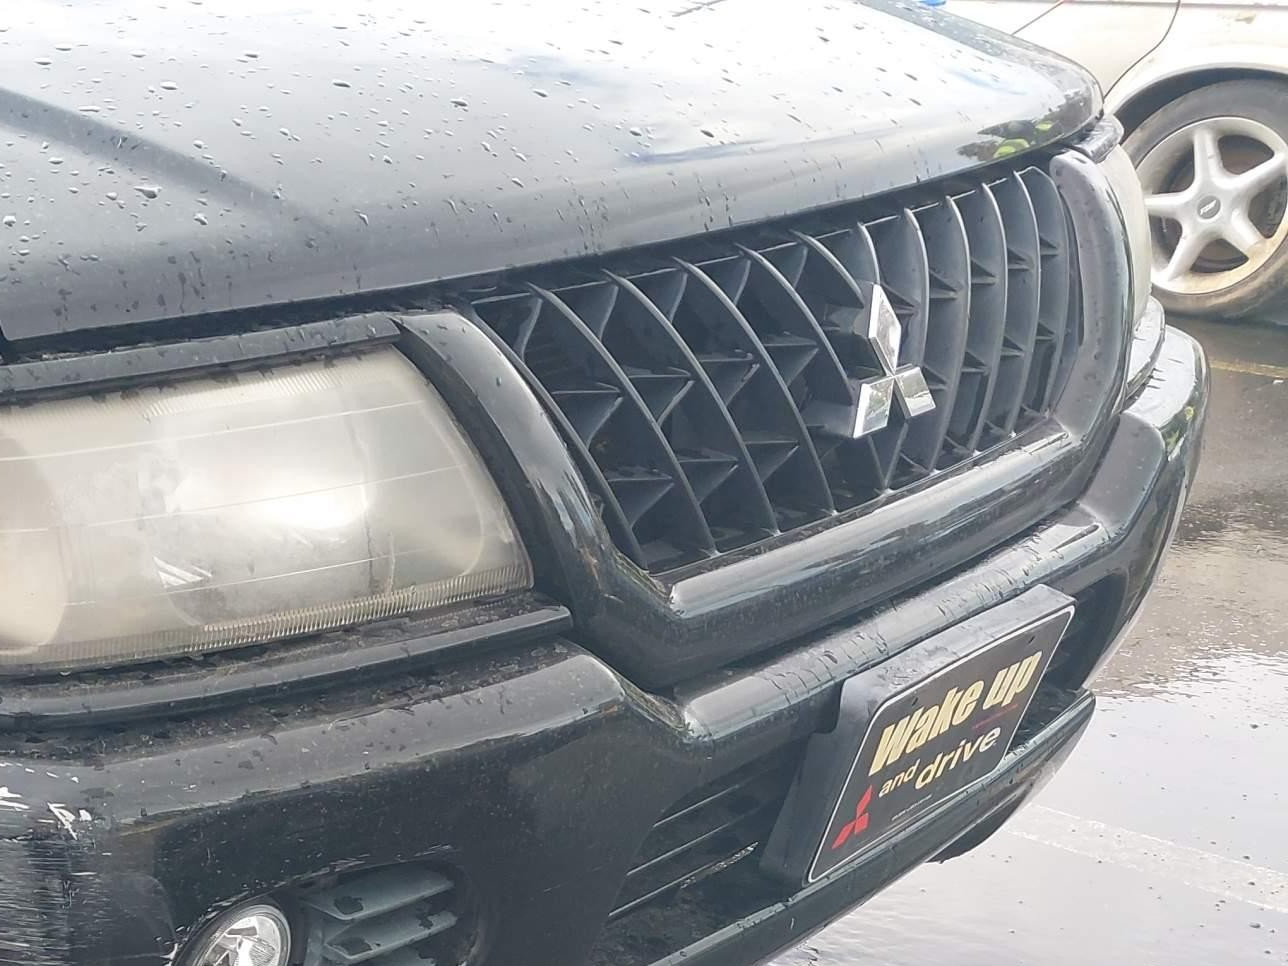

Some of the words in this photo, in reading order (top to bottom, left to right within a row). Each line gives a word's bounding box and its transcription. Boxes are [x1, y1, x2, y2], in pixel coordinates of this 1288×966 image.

[868, 680, 985, 777] Wake
[983, 650, 1043, 712] up
[878, 759, 921, 798] and
[915, 727, 1001, 790] drive
